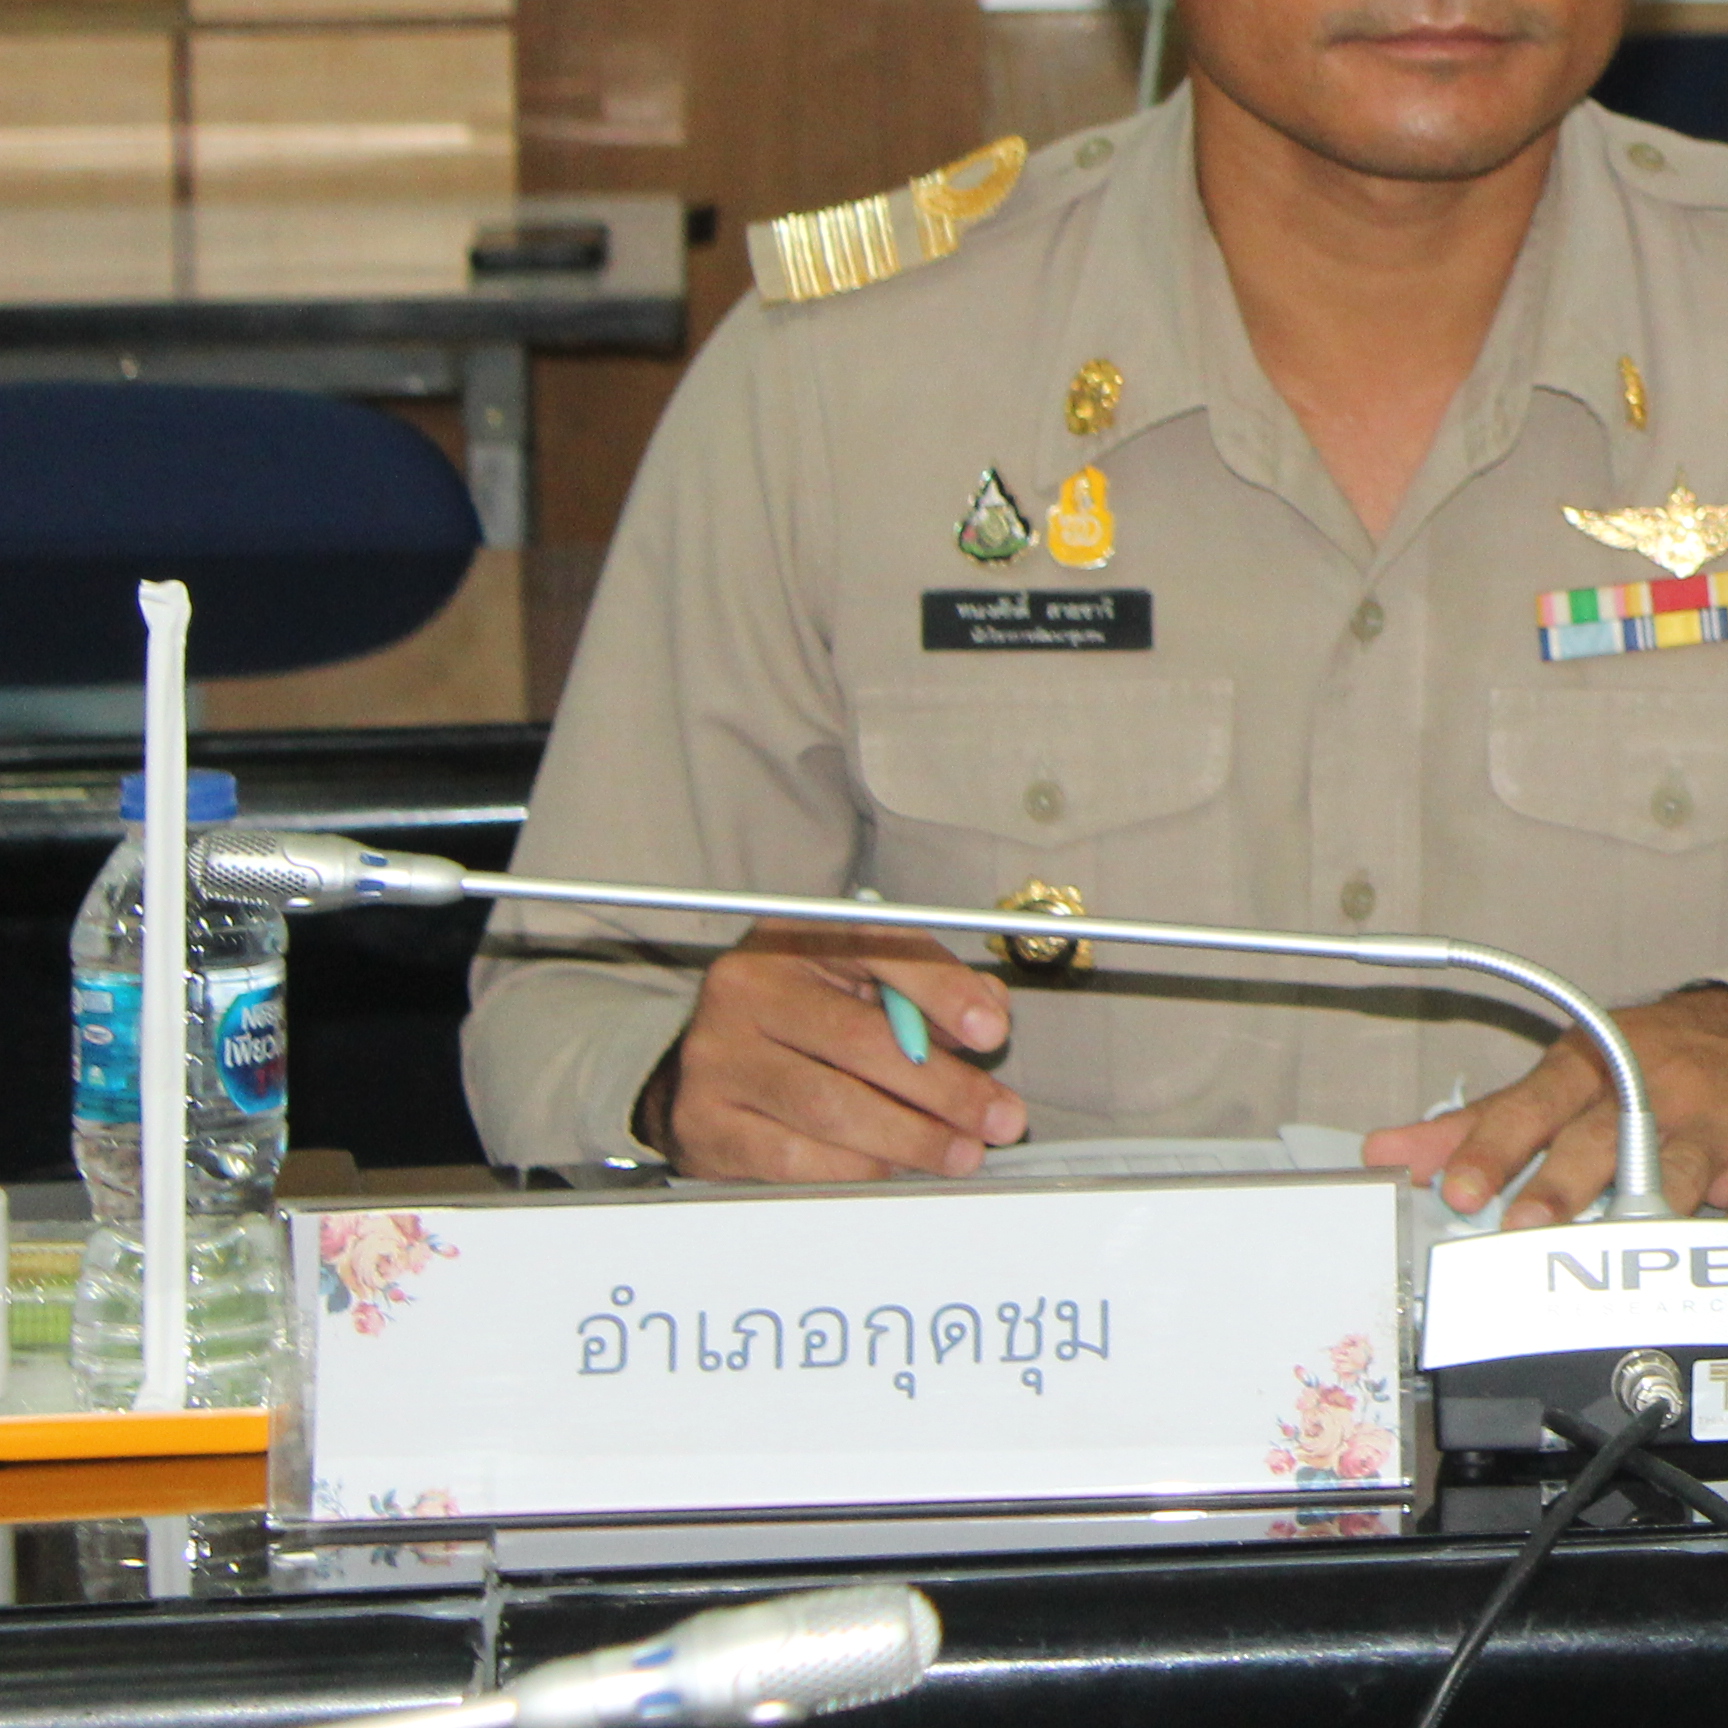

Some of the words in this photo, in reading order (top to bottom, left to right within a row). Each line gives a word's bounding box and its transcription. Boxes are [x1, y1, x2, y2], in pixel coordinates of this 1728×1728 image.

[576, 1284, 1111, 1399] อำเภอกุดชุม
